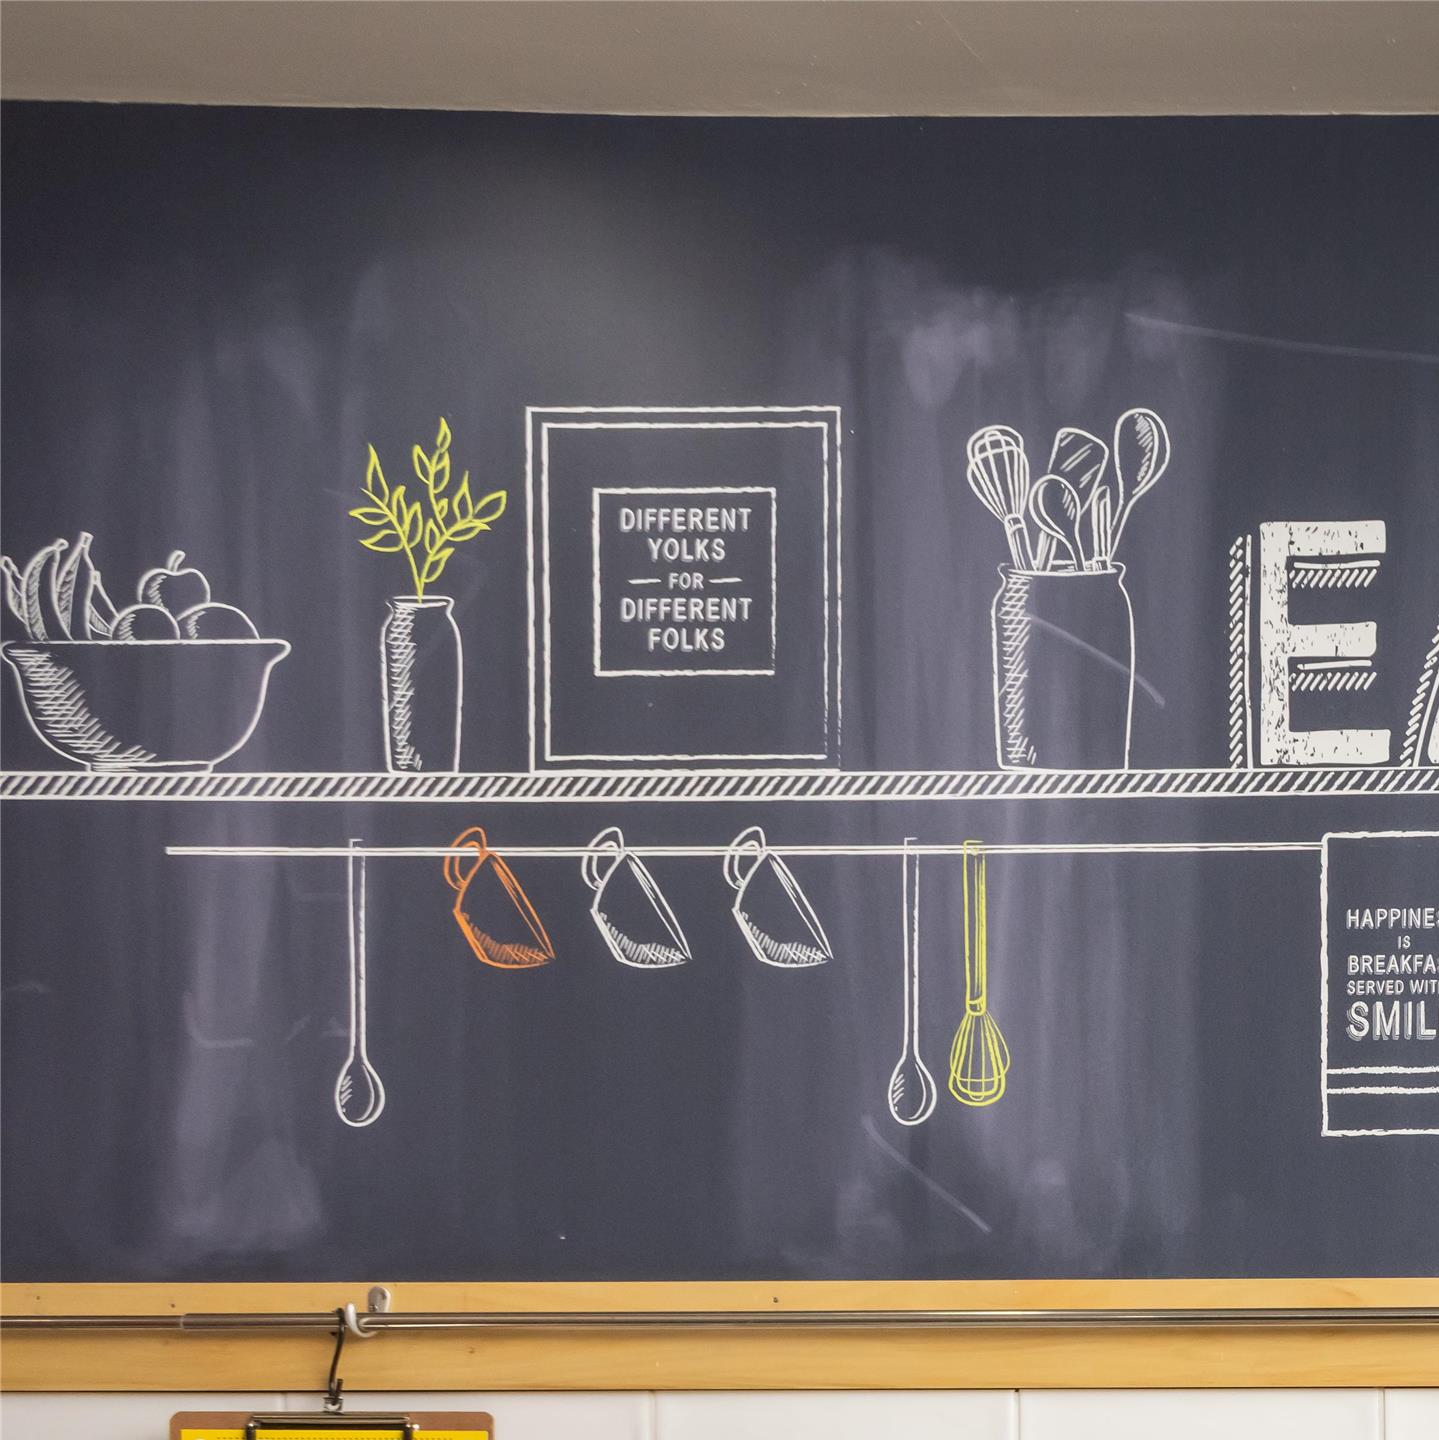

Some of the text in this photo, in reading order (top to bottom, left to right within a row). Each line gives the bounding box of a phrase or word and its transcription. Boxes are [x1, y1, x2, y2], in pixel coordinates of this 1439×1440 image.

[620, 507, 752, 533] DIFFERENT
[648, 537, 726, 562] YOLKS
[668, 572, 705, 590] FOR
[620, 598, 752, 623] DIFFERENT
[648, 627, 725, 652] FOLKS
[1398, 936, 1411, 950] IS
[1347, 980, 1406, 996] SERVED
